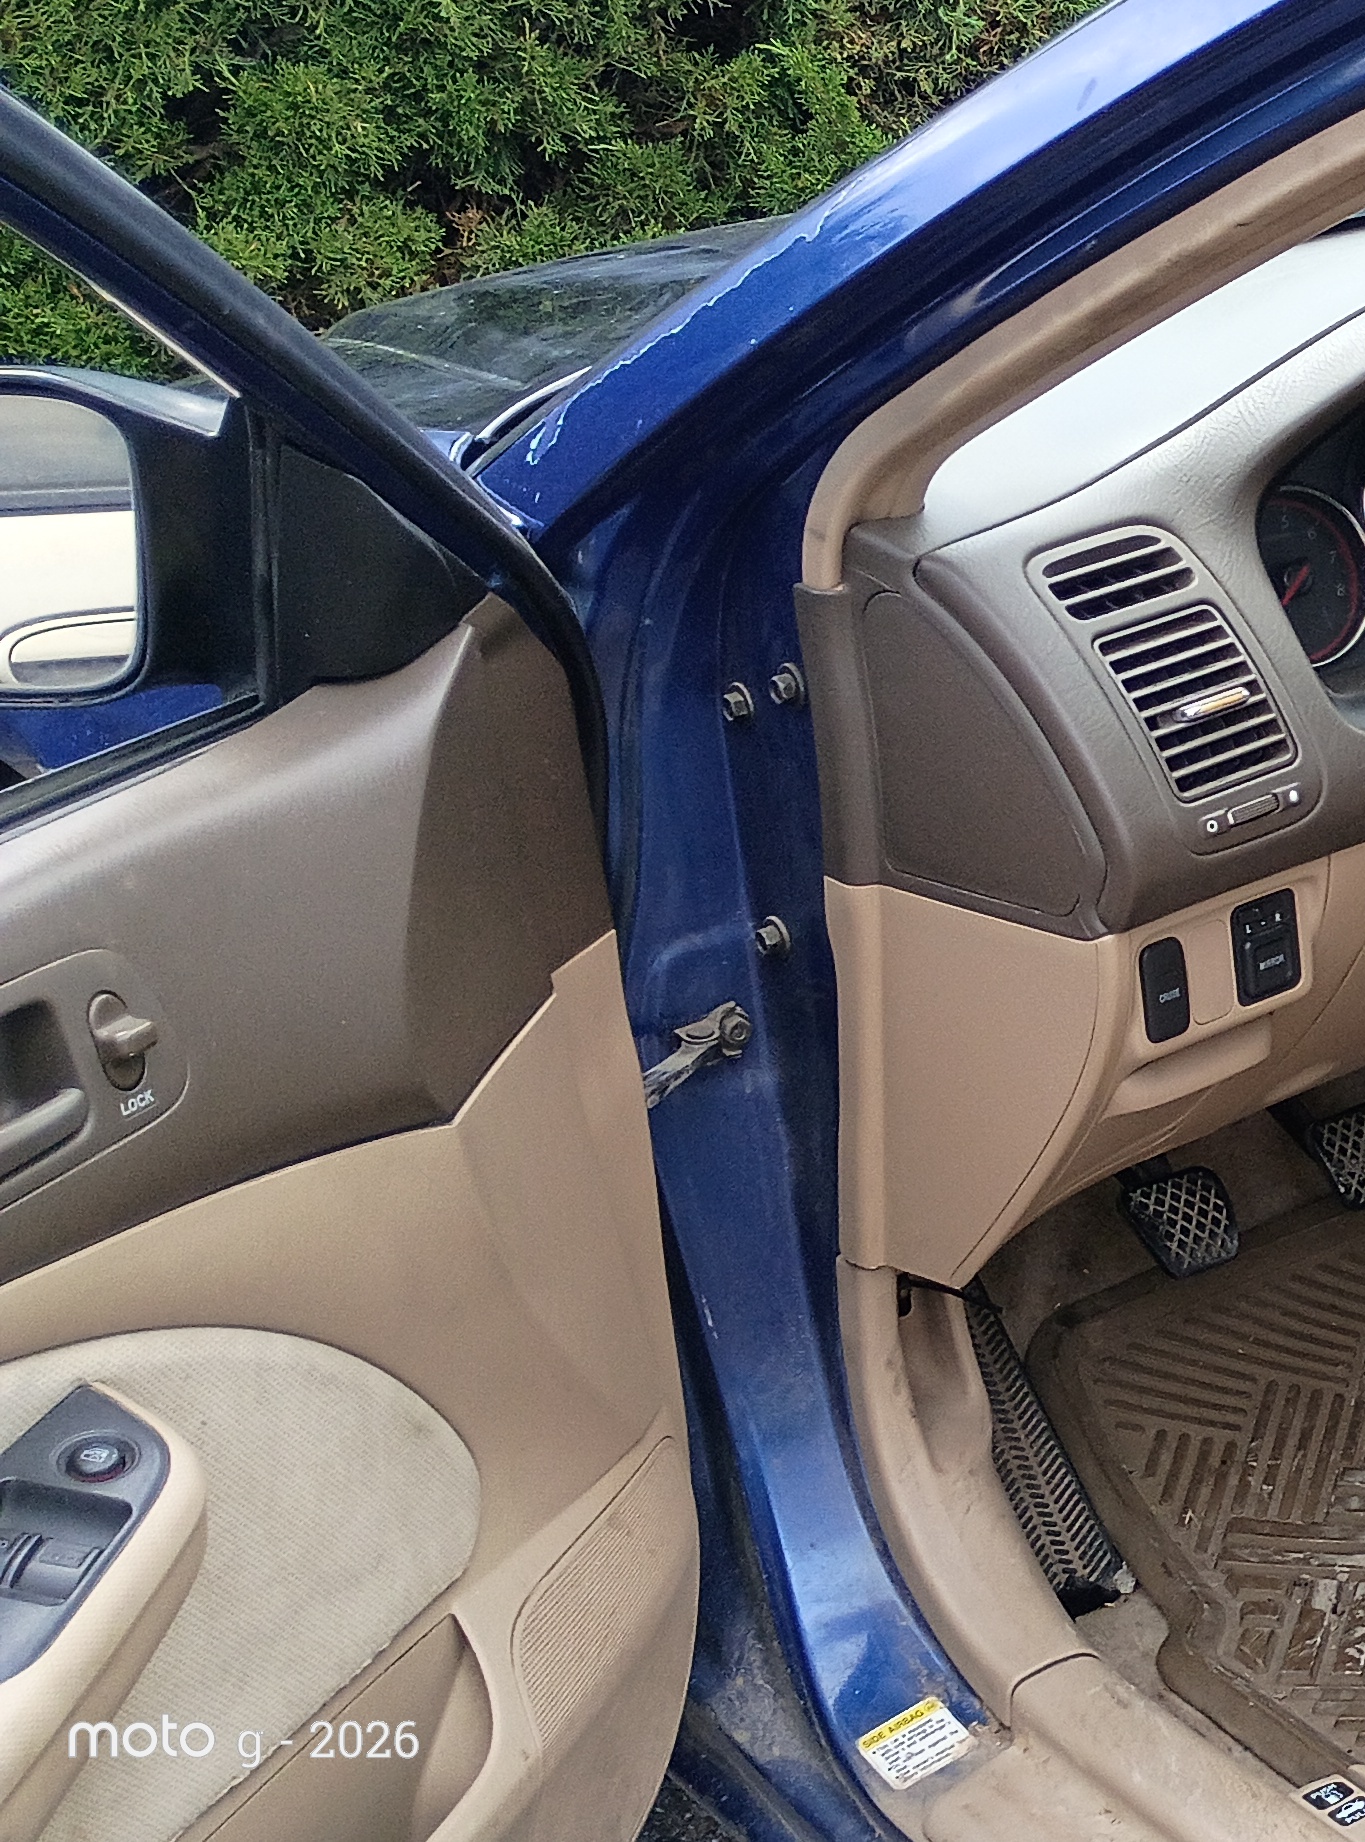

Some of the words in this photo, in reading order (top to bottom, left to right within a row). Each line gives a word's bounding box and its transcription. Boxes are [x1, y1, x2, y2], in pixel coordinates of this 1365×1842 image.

[120, 1089, 155, 1116] LOCK
[862, 1731, 886, 1749] SIDE
[888, 1709, 925, 1733] AIRBAG
